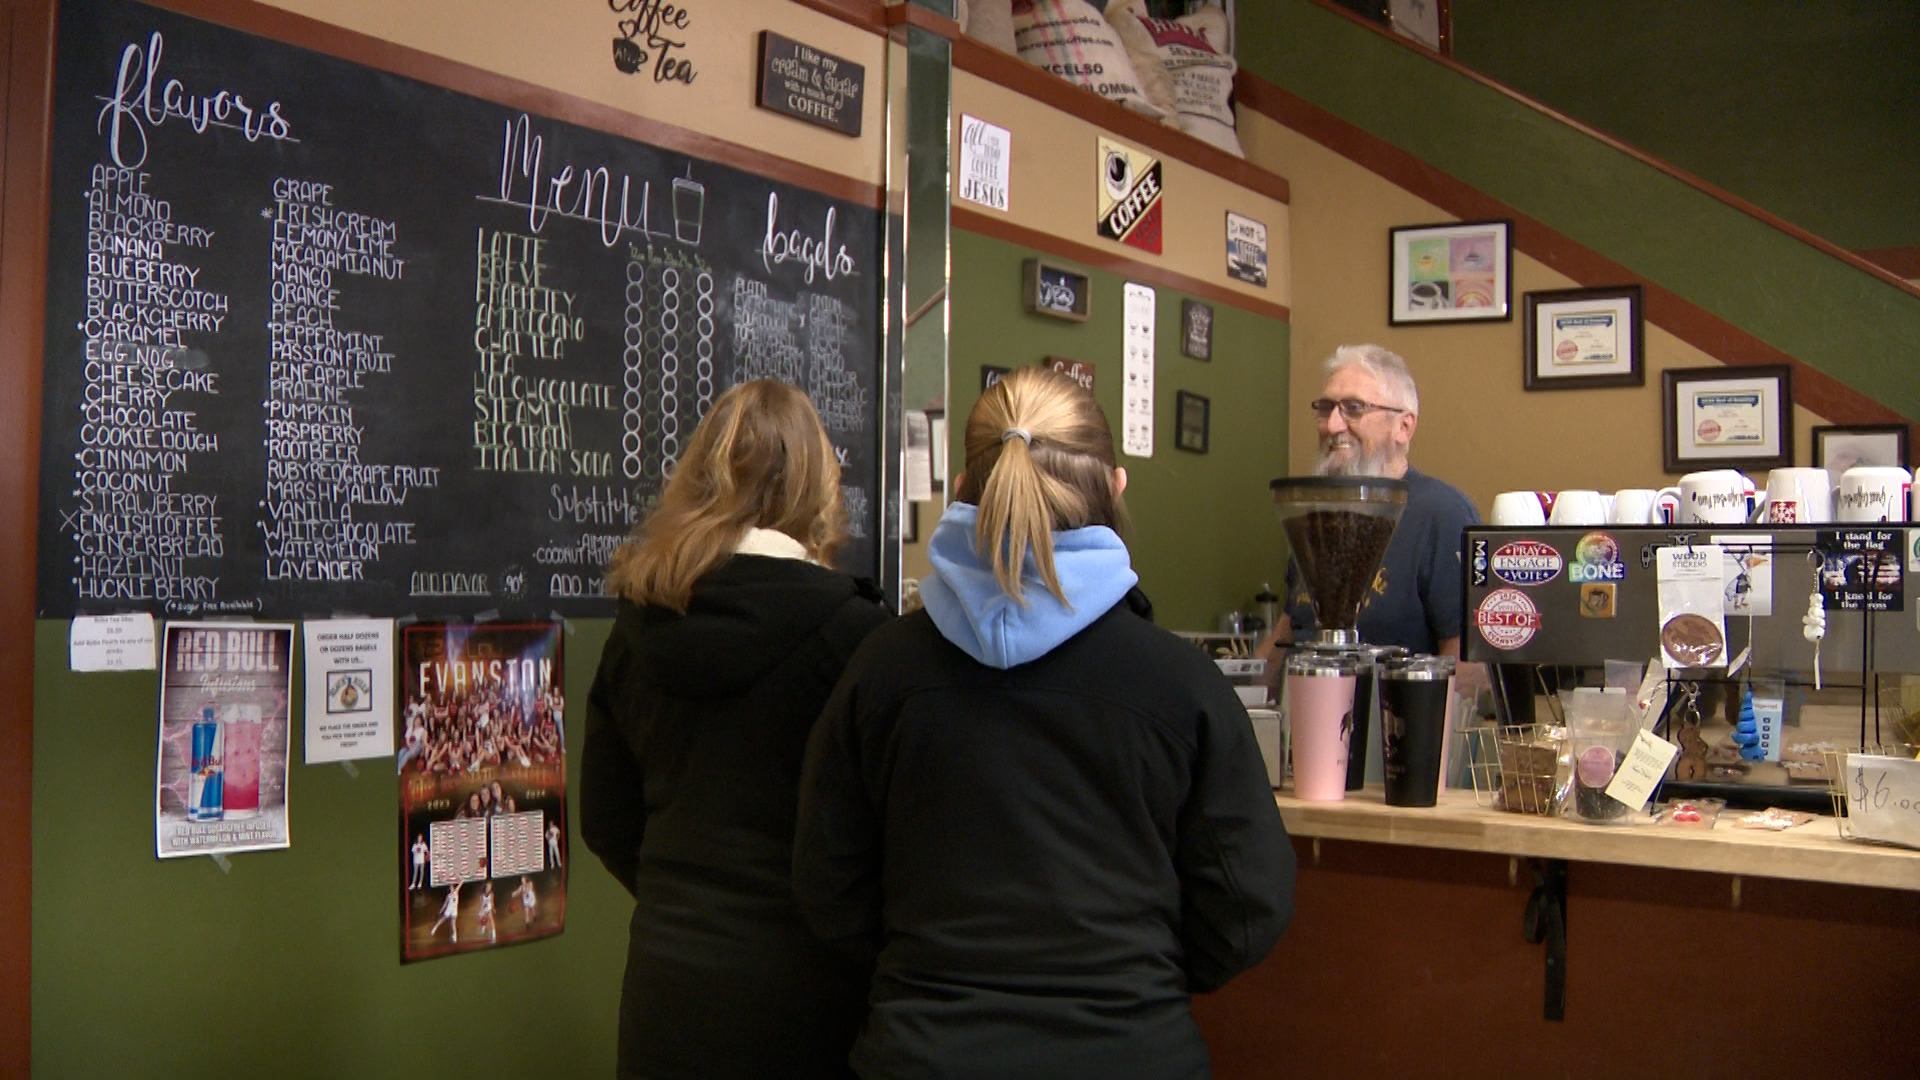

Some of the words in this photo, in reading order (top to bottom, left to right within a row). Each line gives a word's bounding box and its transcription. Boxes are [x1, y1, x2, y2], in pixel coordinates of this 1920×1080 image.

[648, 35, 698, 85] Tea
[771, 57, 809, 83] cream
[801, 47, 820, 65] like
[822, 57, 838, 73] my
[1042, 63, 1103, 75] XCELSO
[97, 31, 291, 171] flavors
[788, 93, 838, 122] COFFEE.
[91, 163, 151, 197] APPLE
[273, 178, 333, 206] GRAPE
[500, 112, 650, 248] Menu
[964, 179, 1005, 208] JESUS
[90, 189, 171, 222] ALMOND
[1110, 171, 1161, 235] COFFEE
[88, 212, 215, 247] BLACKBERRY
[273, 219, 394, 258] LEMON/LIME
[477, 227, 549, 258] LATTE
[763, 191, 857, 284] bagels
[88, 232, 162, 260] BANANA
[88, 253, 201, 288] BLUEBERRY
[272, 261, 331, 288] MANGO
[87, 278, 228, 313] BUTTERSCOTCH
[272, 282, 341, 310] ORANGE
[271, 304, 333, 327] PEACH
[476, 303, 584, 340] AMERICANO
[85, 320, 188, 349] CARAMEL
[271, 324, 383, 353] PEPPERMINT
[475, 327, 523, 355] CHAI
[531, 333, 565, 360] TEA
[86, 341, 127, 362] EGG
[136, 347, 174, 368] NOG
[477, 350, 515, 376] TEA
[270, 361, 365, 389] PINEAPPLE
[84, 383, 172, 409] CHERRY
[269, 381, 349, 404] PRALINE
[85, 402, 198, 431] CHOCOLATE
[269, 400, 353, 425] PUMPKIN
[474, 395, 570, 426] STEAMER
[80, 424, 154, 448] COOKIE
[161, 430, 218, 452] DOUGH
[269, 420, 364, 444] RASPBERRY
[80, 448, 187, 472] CINNAMON
[473, 446, 562, 473] ITALIAN
[570, 449, 613, 477] SODA
[80, 471, 173, 492] COCONUT
[80, 491, 217, 516] STRAWBERRY
[268, 501, 352, 523] VANILLA
[548, 483, 639, 525] Substitute
[79, 533, 224, 557] GINGERBREAD
[263, 520, 320, 541] WHITE
[323, 522, 416, 545] CHOCOLATE
[1843, 541, 1860, 549] the
[1866, 541, 1884, 550] flag
[1845, 532, 1871, 540] stand
[1877, 532, 1892, 540] for
[264, 541, 380, 561] WATERMELON
[1500, 557, 1553, 568] ENGAGE
[1513, 544, 1541, 555] PRAY
[1672, 552, 1707, 560] WOOD
[80, 556, 184, 577] HAZELNUT
[266, 559, 364, 581] LAVENDER
[1511, 570, 1542, 581] VOTE
[1571, 563, 1624, 580] BONE
[550, 573, 582, 596] ADD
[1878, 592, 1893, 600] for
[1478, 611, 1513, 625] BEST
[1516, 614, 1535, 626] OF
[176, 631, 220, 672] RED
[226, 631, 279, 672] BULL
[419, 657, 552, 698] EVANSTON
